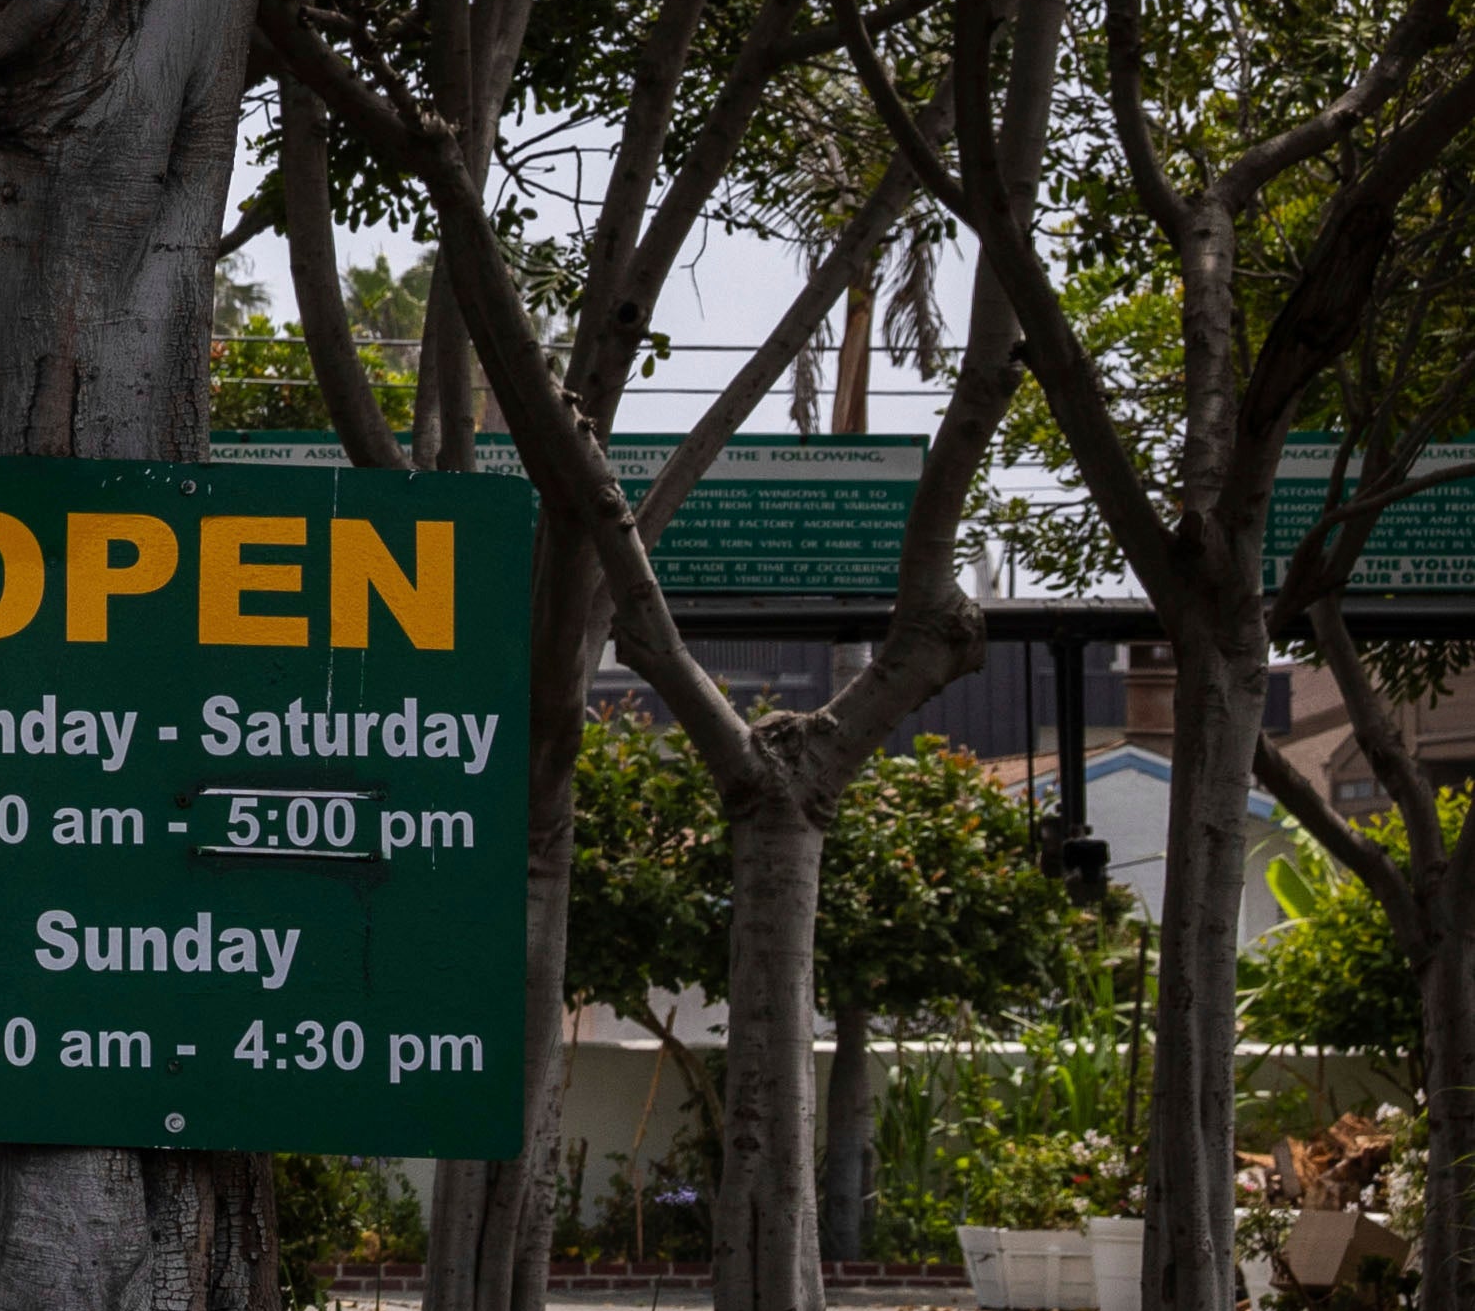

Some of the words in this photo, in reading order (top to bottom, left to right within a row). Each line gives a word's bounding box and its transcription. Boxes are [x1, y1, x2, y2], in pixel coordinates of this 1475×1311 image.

[725, 451, 758, 460] THE
[1365, 559, 1401, 570] THE
[201, 695, 499, 774] Saturday
[52, 805, 144, 844] am
[226, 797, 356, 847] 5:00
[380, 809, 474, 858] pm
[34, 910, 300, 988] Sunday
[59, 1028, 152, 1068] am
[233, 1020, 364, 1070] 4:30
[389, 1032, 483, 1083] pm
